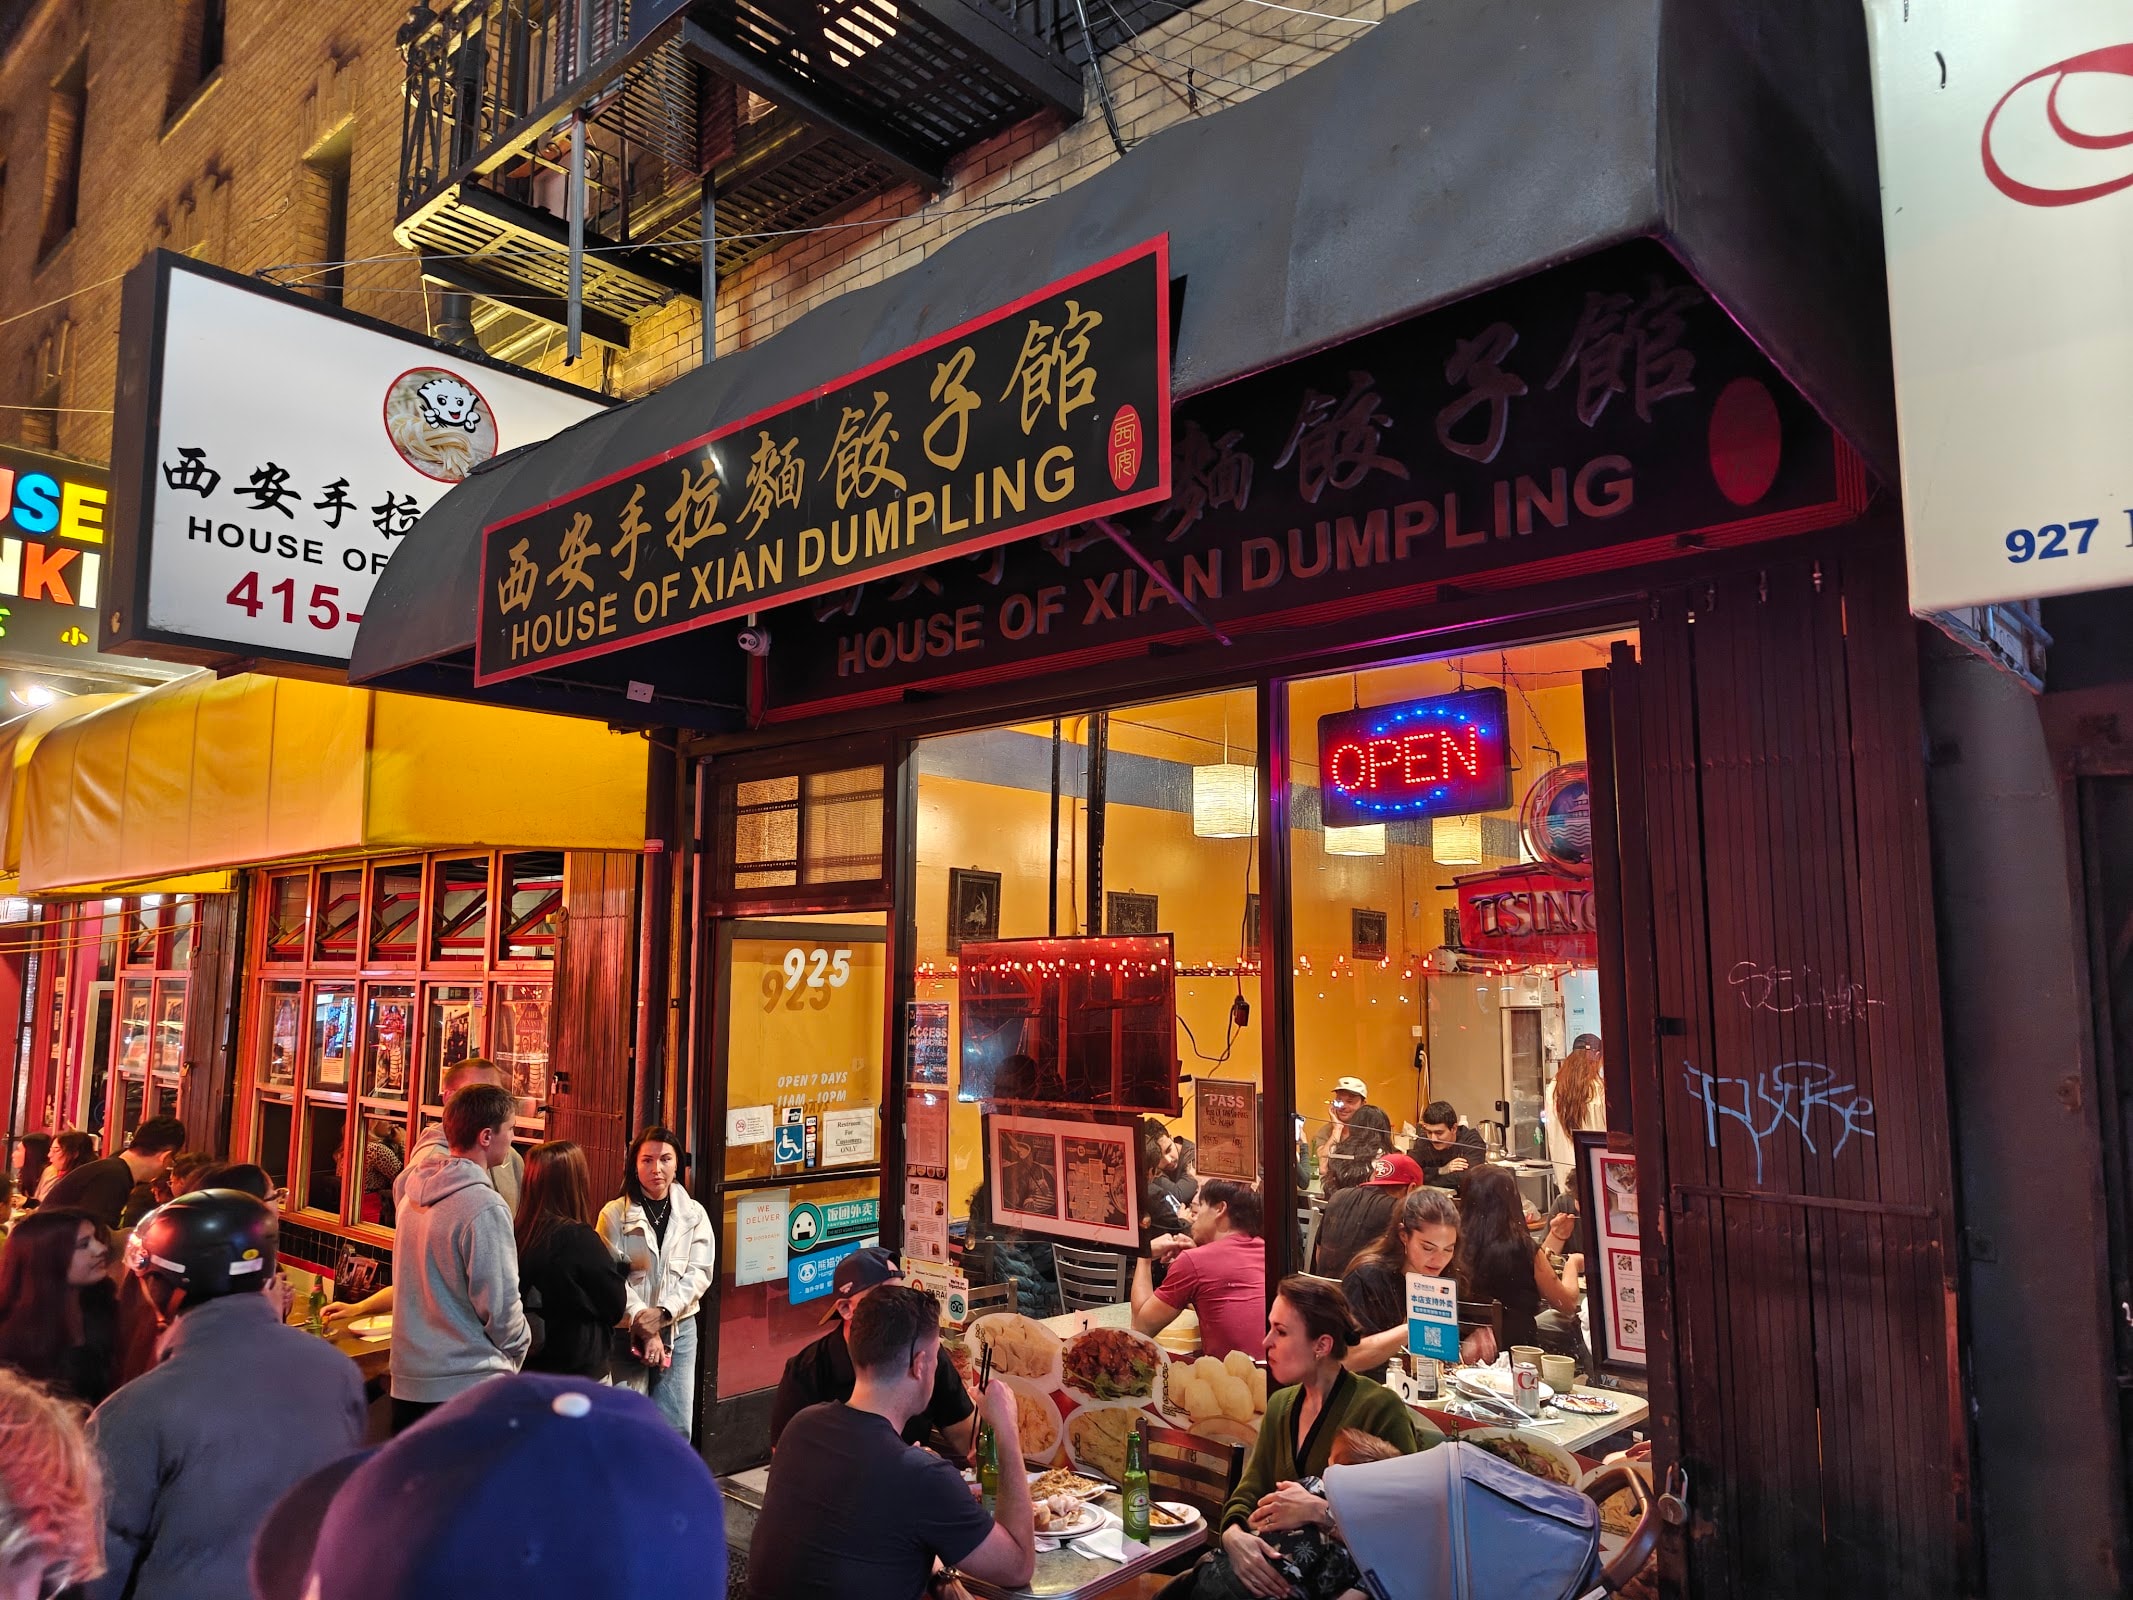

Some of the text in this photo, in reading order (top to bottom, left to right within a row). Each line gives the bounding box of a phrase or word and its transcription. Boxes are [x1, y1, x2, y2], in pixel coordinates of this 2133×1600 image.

[188, 516, 389, 575] HOUSE OF
[2006, 518, 2099, 563] 927
[510, 445, 1076, 660] HOUSE OF XIAN DUMPLING
[836, 454, 1635, 677] HOUSE OF XIAN DUMPLING
[1331, 726, 1477, 790] OPEN
[783, 948, 853, 991] 925
[909, 1026, 947, 1038] ACCESS
[777, 1071, 848, 1088] OPEN 7 DAYS
[777, 1093, 805, 1107] 11AM
[817, 1091, 846, 1104] 10PM
[1209, 1095, 1245, 1108] PASS
[837, 1120, 861, 1128] Restroom
[840, 1145, 857, 1153] ONLY
[757, 1204, 770, 1212] WE
[746, 1213, 780, 1225] DELIVER
